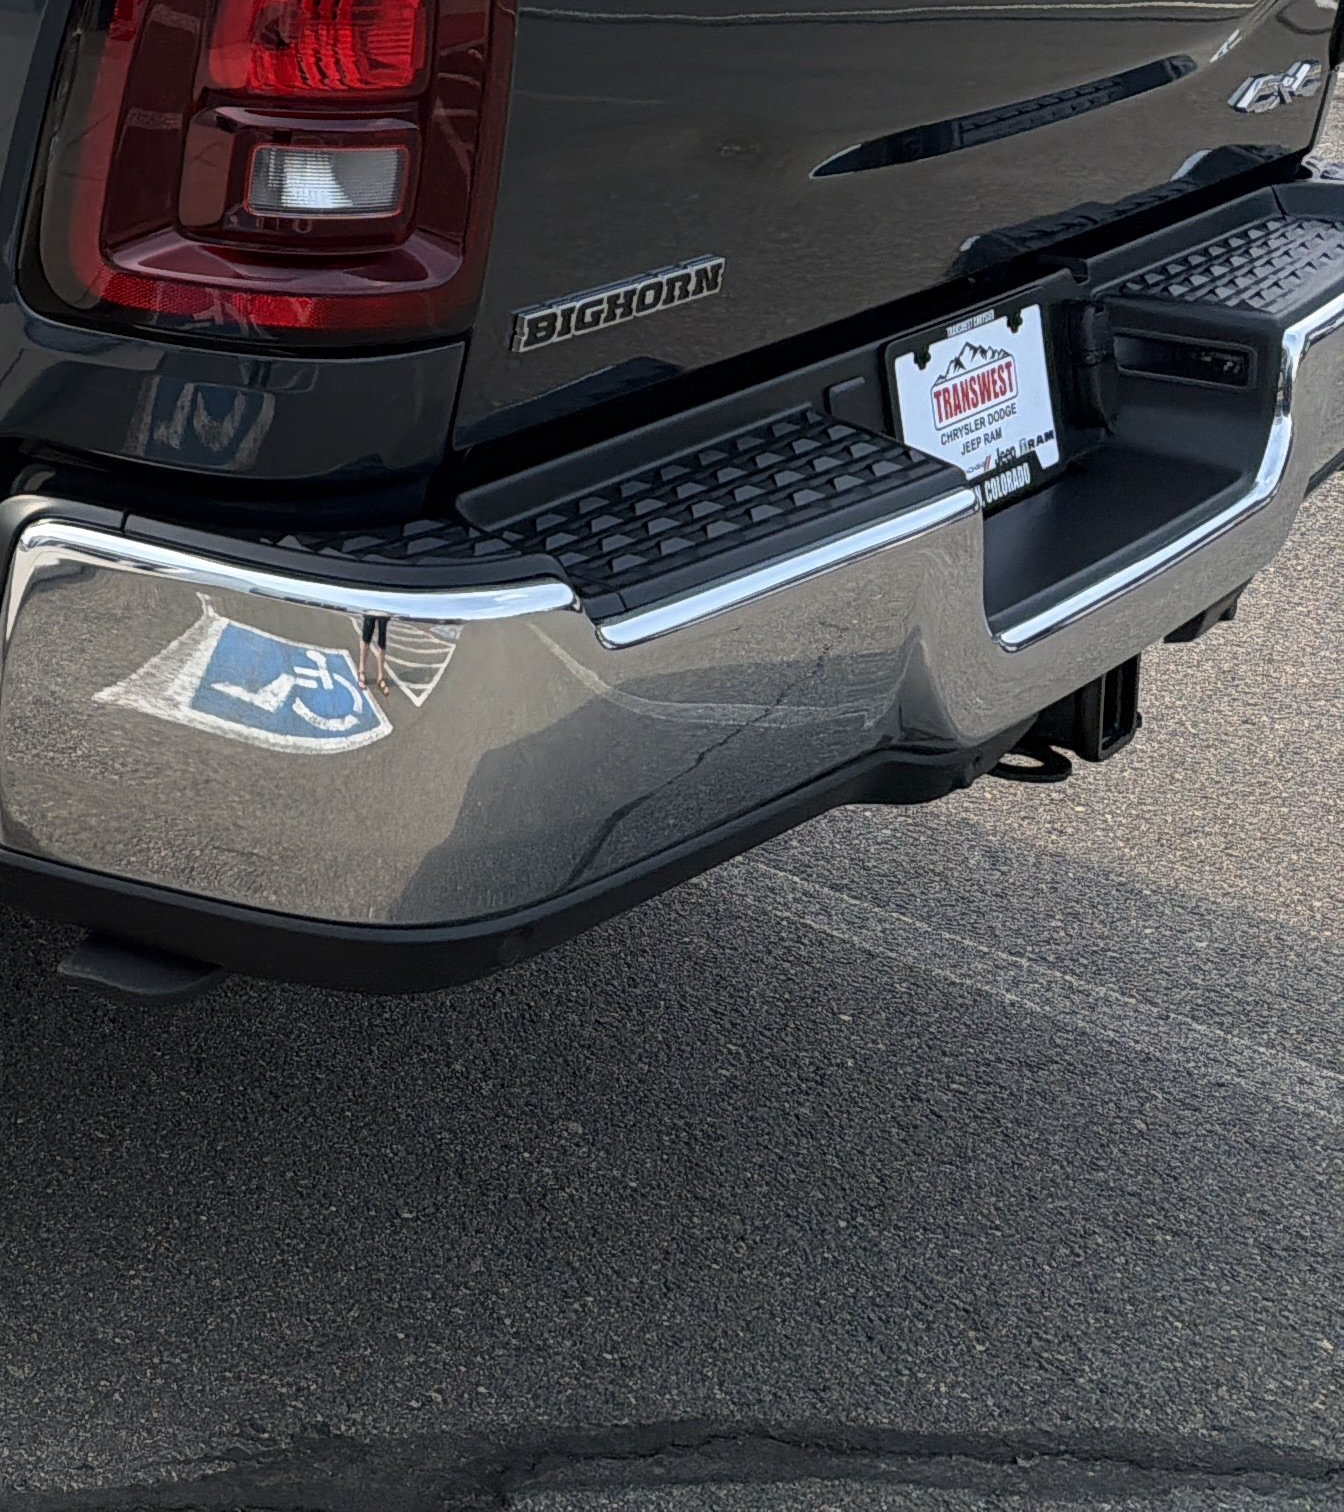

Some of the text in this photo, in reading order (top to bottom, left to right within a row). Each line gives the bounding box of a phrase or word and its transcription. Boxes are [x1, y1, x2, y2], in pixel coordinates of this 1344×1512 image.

[511, 254, 725, 353] BIGHORN
[933, 361, 1014, 424] TRANSWEST
[940, 402, 1017, 446] CHRYSLER DODGE
[961, 427, 1003, 456] JEEP RAM
[1027, 429, 1055, 450] RAM
[984, 462, 1031, 504] COLORADO
